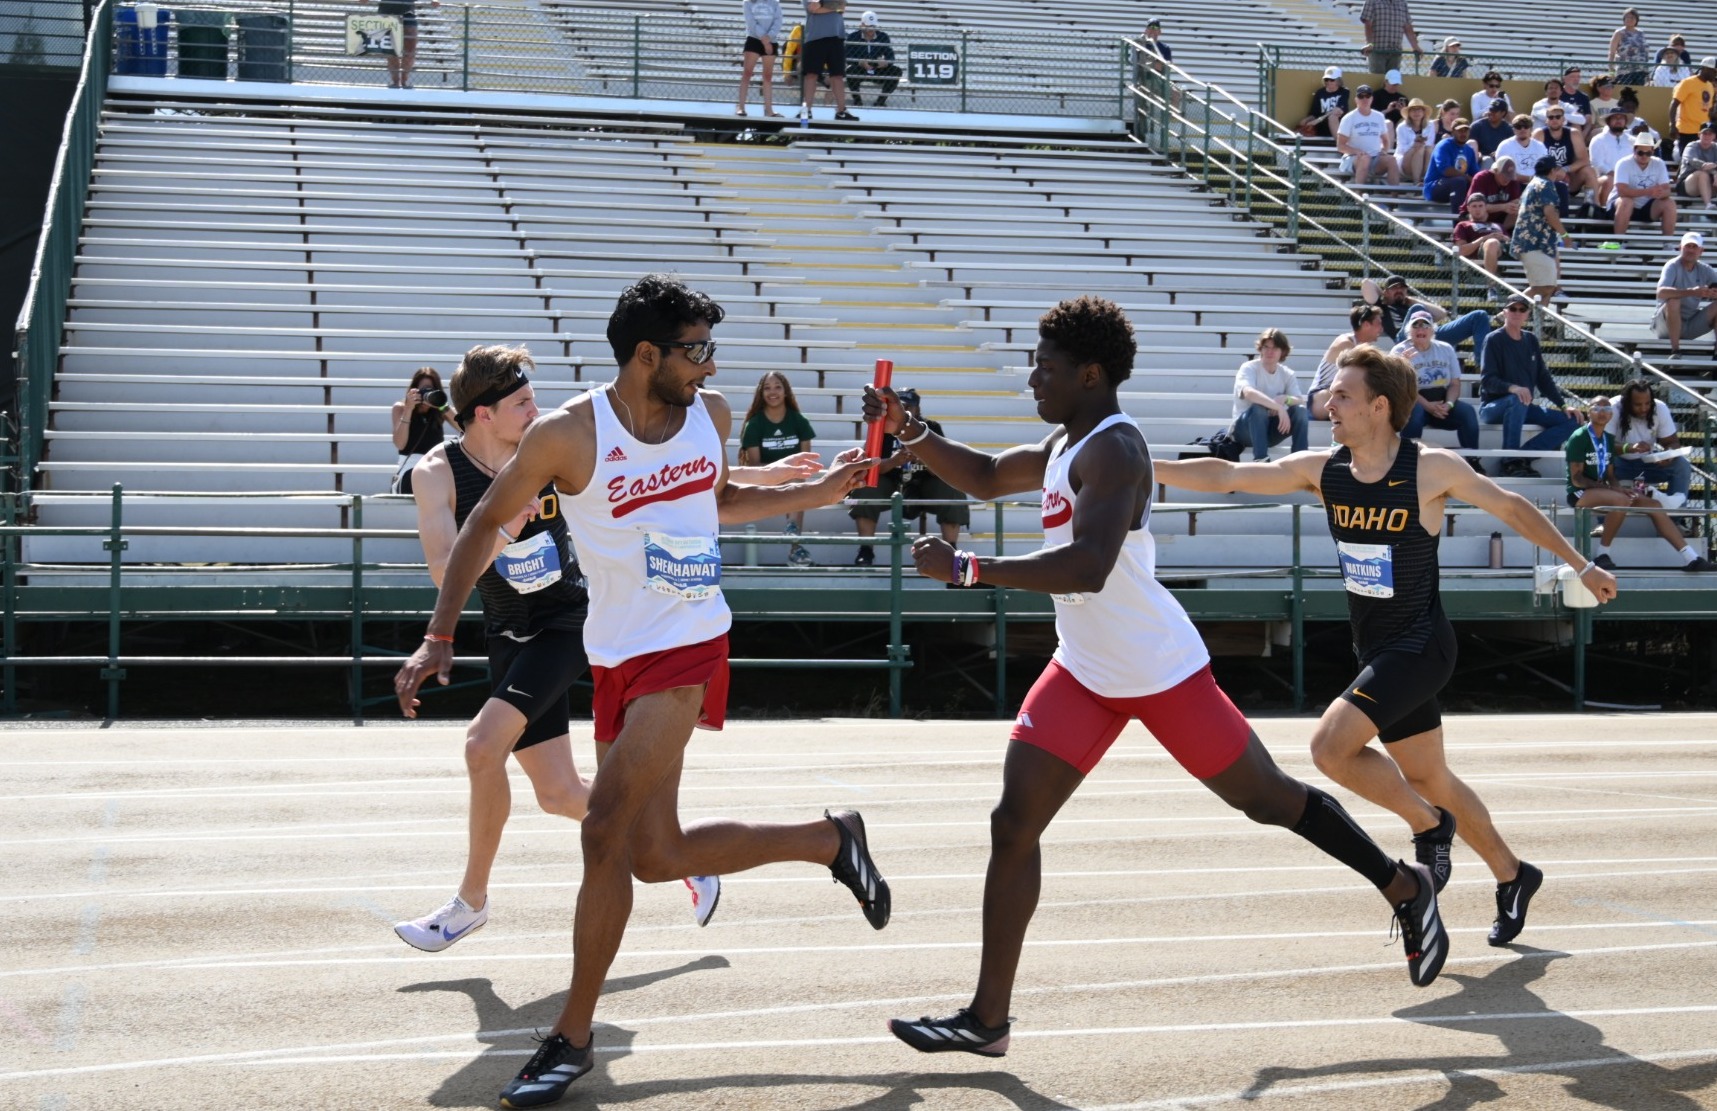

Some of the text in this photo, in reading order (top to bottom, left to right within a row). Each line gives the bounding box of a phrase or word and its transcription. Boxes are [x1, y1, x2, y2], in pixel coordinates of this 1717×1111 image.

[351, 20, 398, 32] SECTION
[911, 51, 957, 60] SECTION
[914, 64, 954, 78] 119
[607, 456, 714, 502] Eastern
[1332, 504, 1409, 531] IDAHO
[508, 556, 545, 576] BRIGHT
[650, 556, 716, 577] SHEKHAWAT
[1345, 562, 1382, 577] WATKINS
